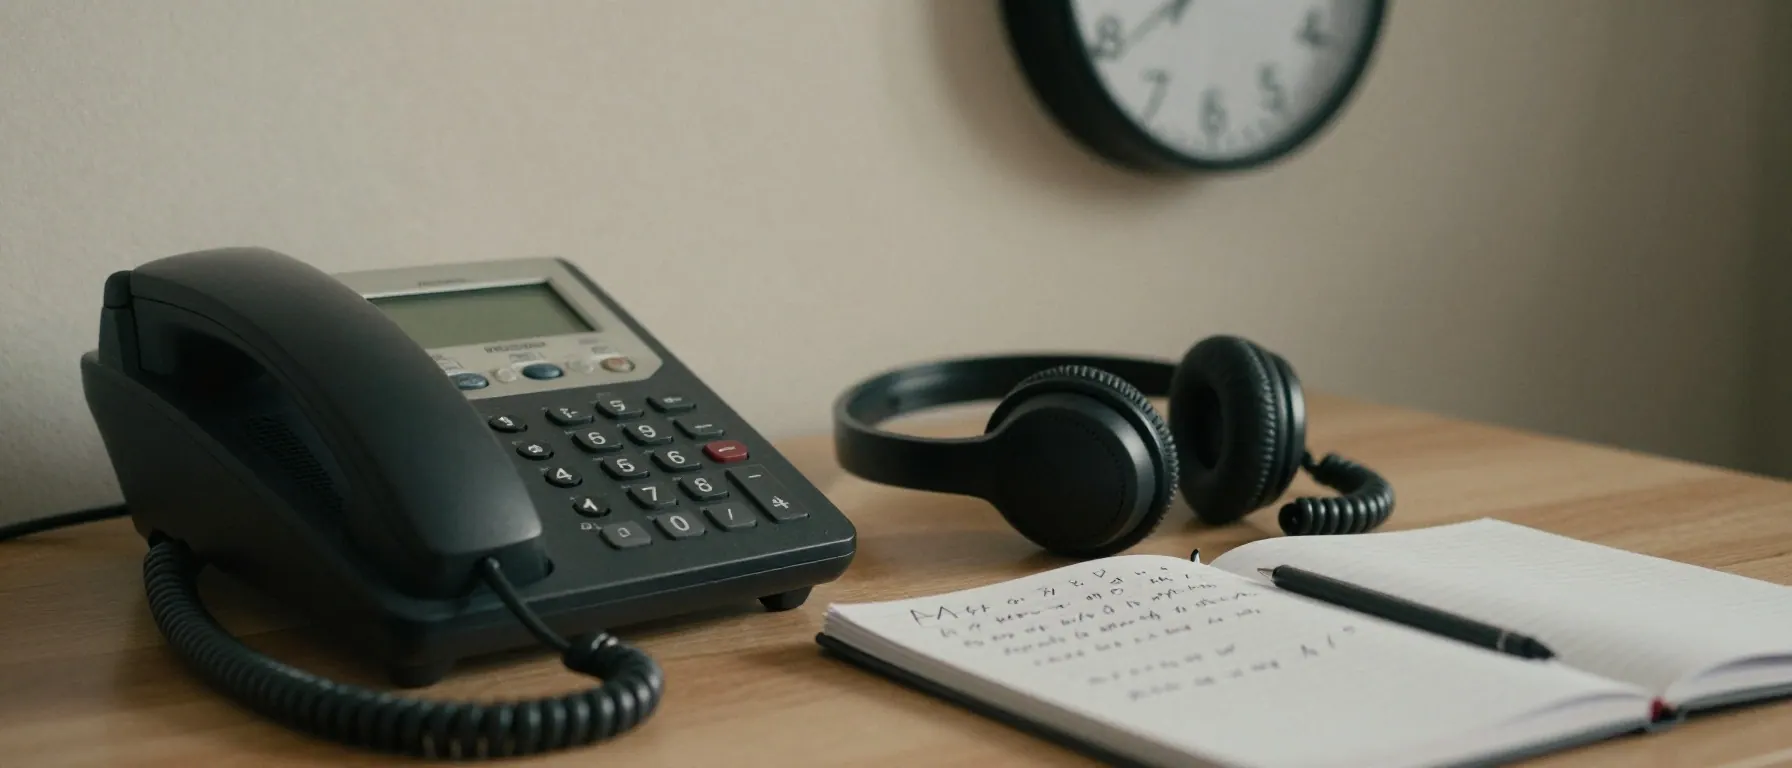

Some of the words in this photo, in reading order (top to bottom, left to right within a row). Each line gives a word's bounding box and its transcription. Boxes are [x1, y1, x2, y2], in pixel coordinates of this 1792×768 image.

[1142, 67, 1170, 123] 7
[1258, 63, 1287, 114] 5
[1200, 87, 1227, 137] 6
[588, 431, 606, 445] 6
[638, 424, 657, 438] 9
[667, 450, 686, 464] 6
[556, 467, 573, 481] 4
[694, 477, 713, 492] 8
[641, 486, 658, 501] 7
[669, 515, 690, 531] 0
